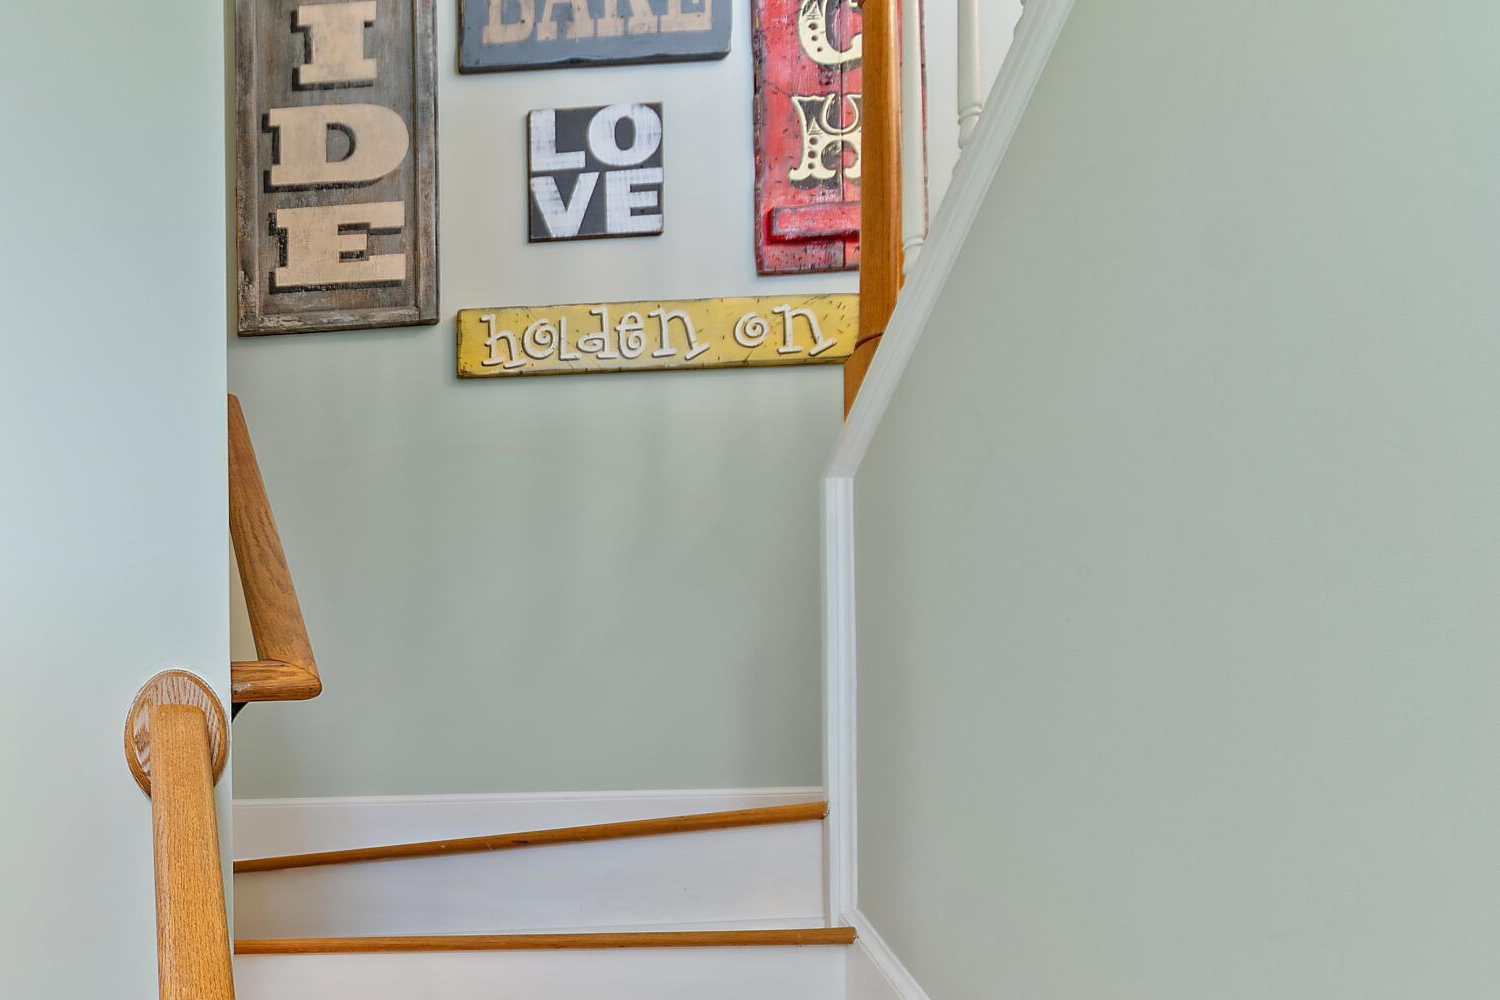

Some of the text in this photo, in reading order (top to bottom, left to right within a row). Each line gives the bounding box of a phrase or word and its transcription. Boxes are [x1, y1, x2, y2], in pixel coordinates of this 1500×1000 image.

[530, 103, 662, 171] LO
[531, 167, 664, 237] VE
[479, 303, 838, 370] holden on
